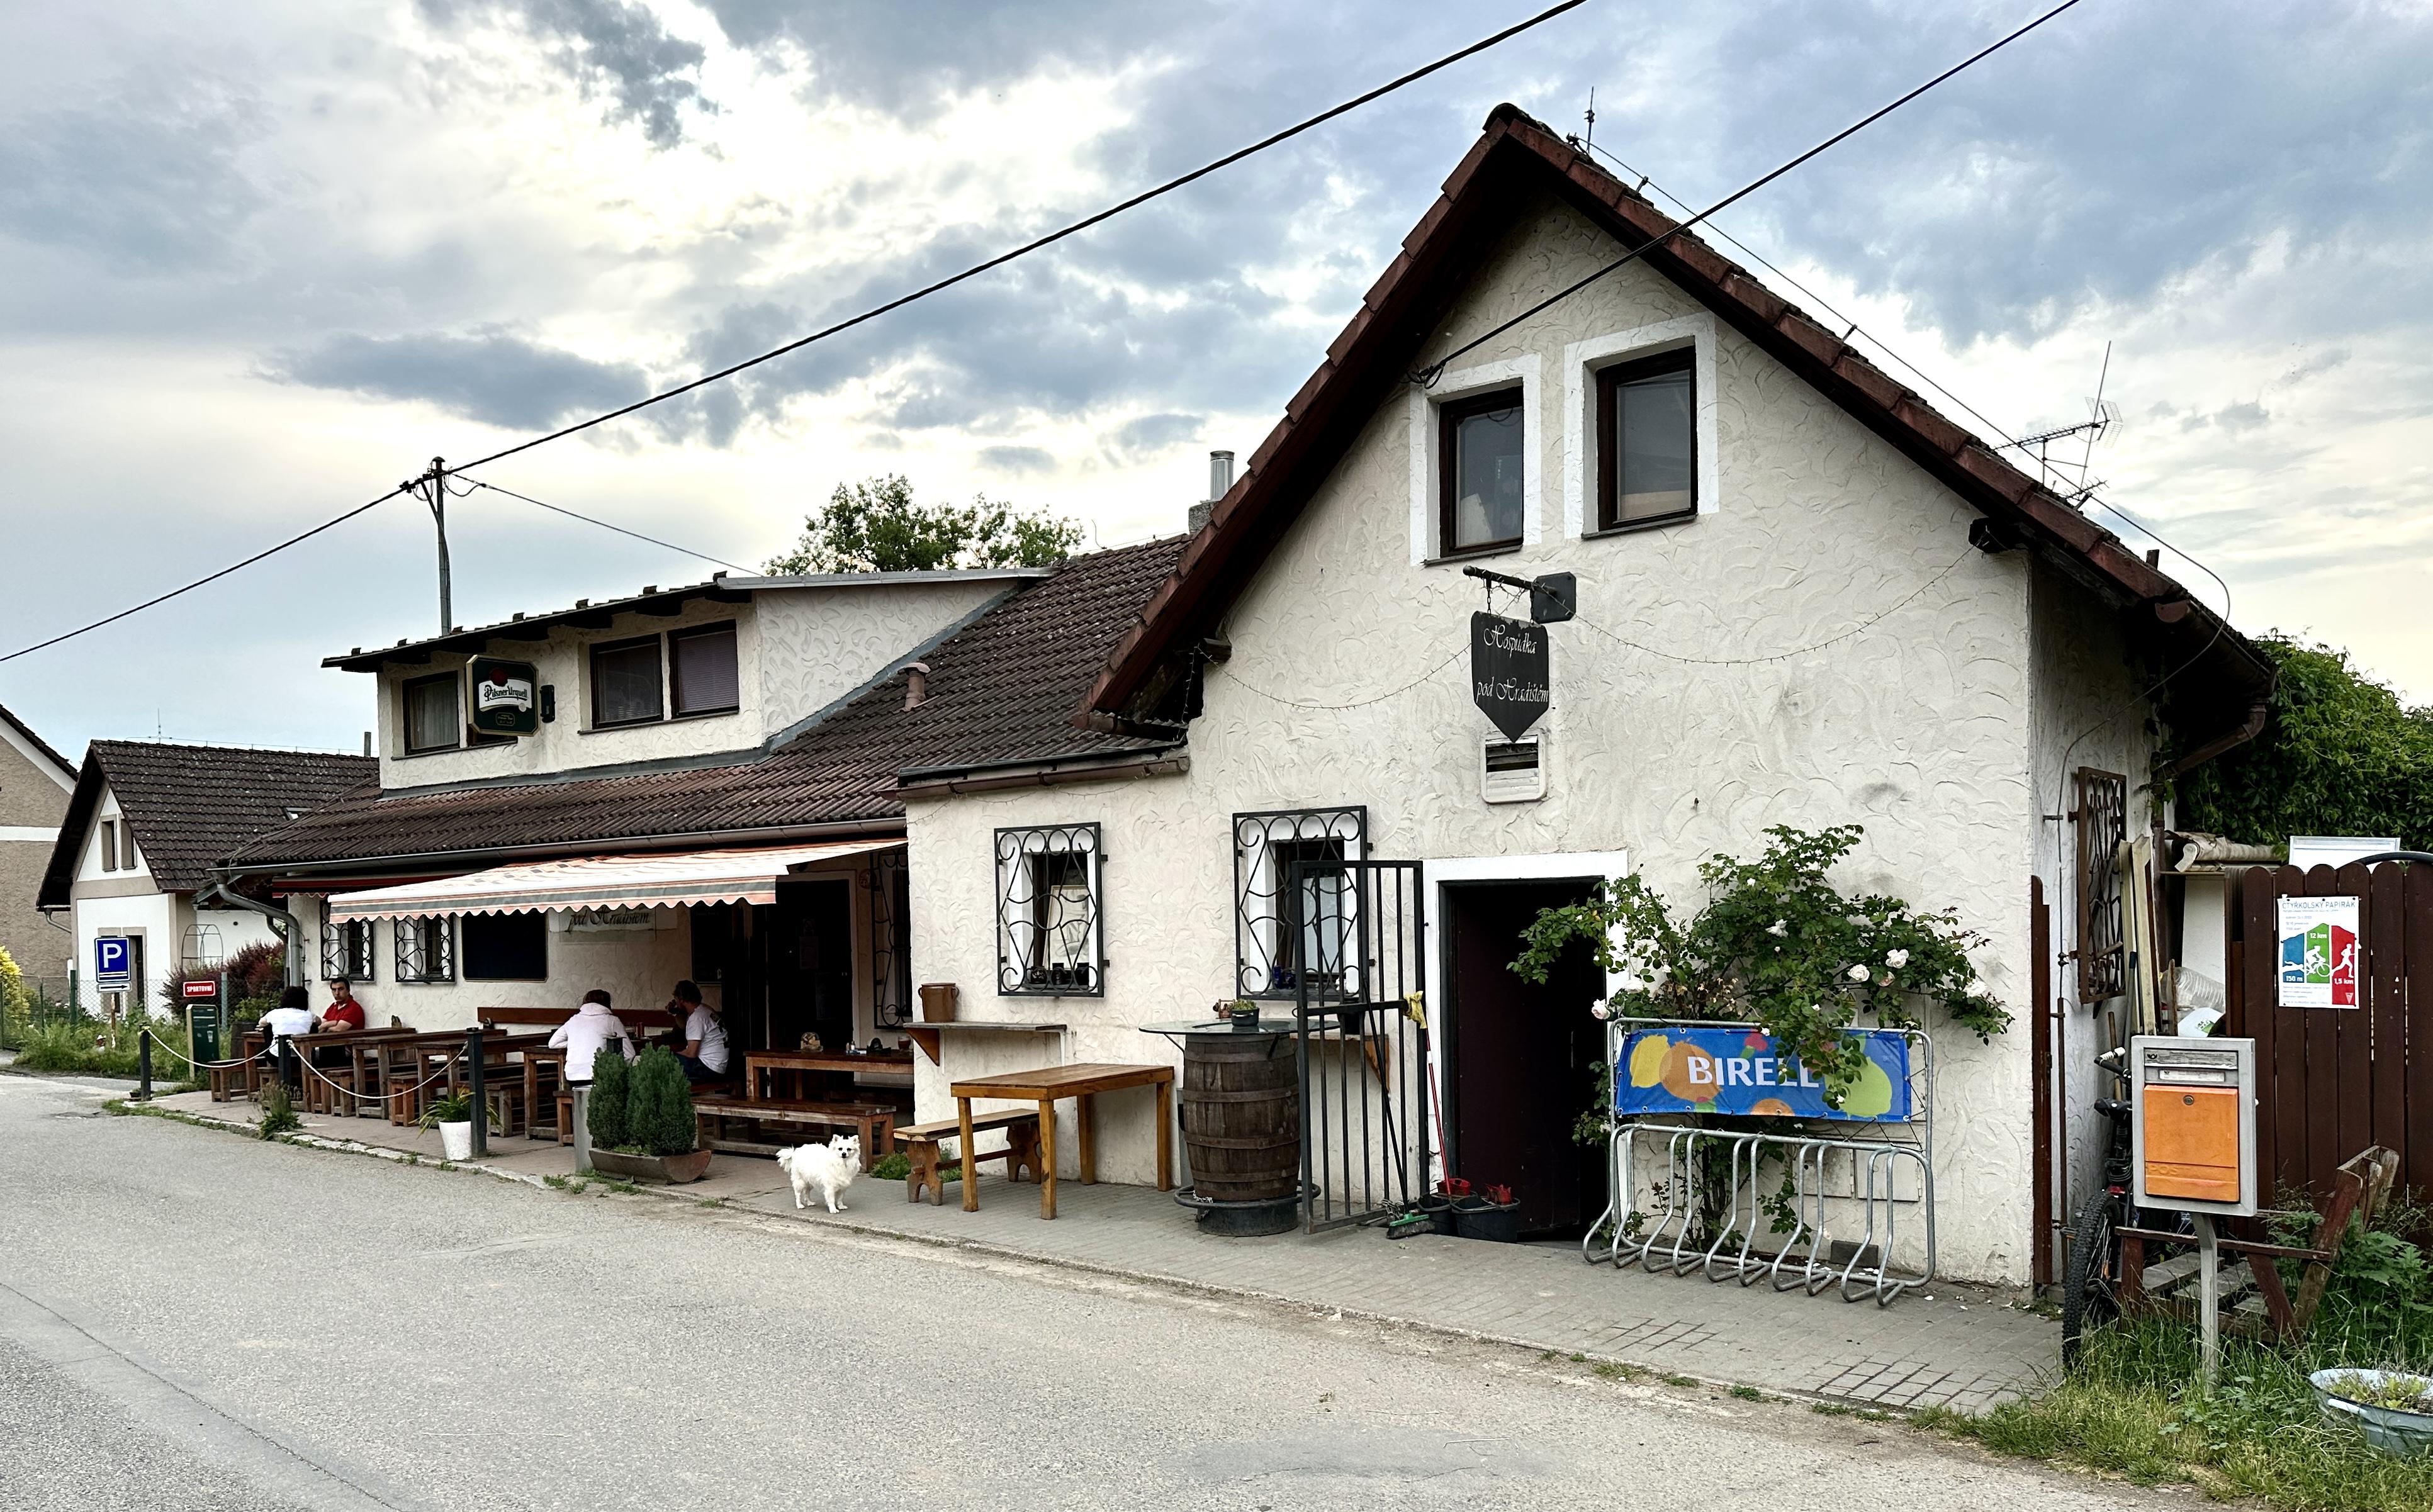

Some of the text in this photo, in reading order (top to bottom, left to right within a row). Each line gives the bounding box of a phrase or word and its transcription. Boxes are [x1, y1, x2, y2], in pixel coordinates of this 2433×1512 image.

[484, 684, 528, 702] Pilsner Urquell
[1476, 676, 1549, 703] pod Hradištěm
[103, 943, 122, 968] P
